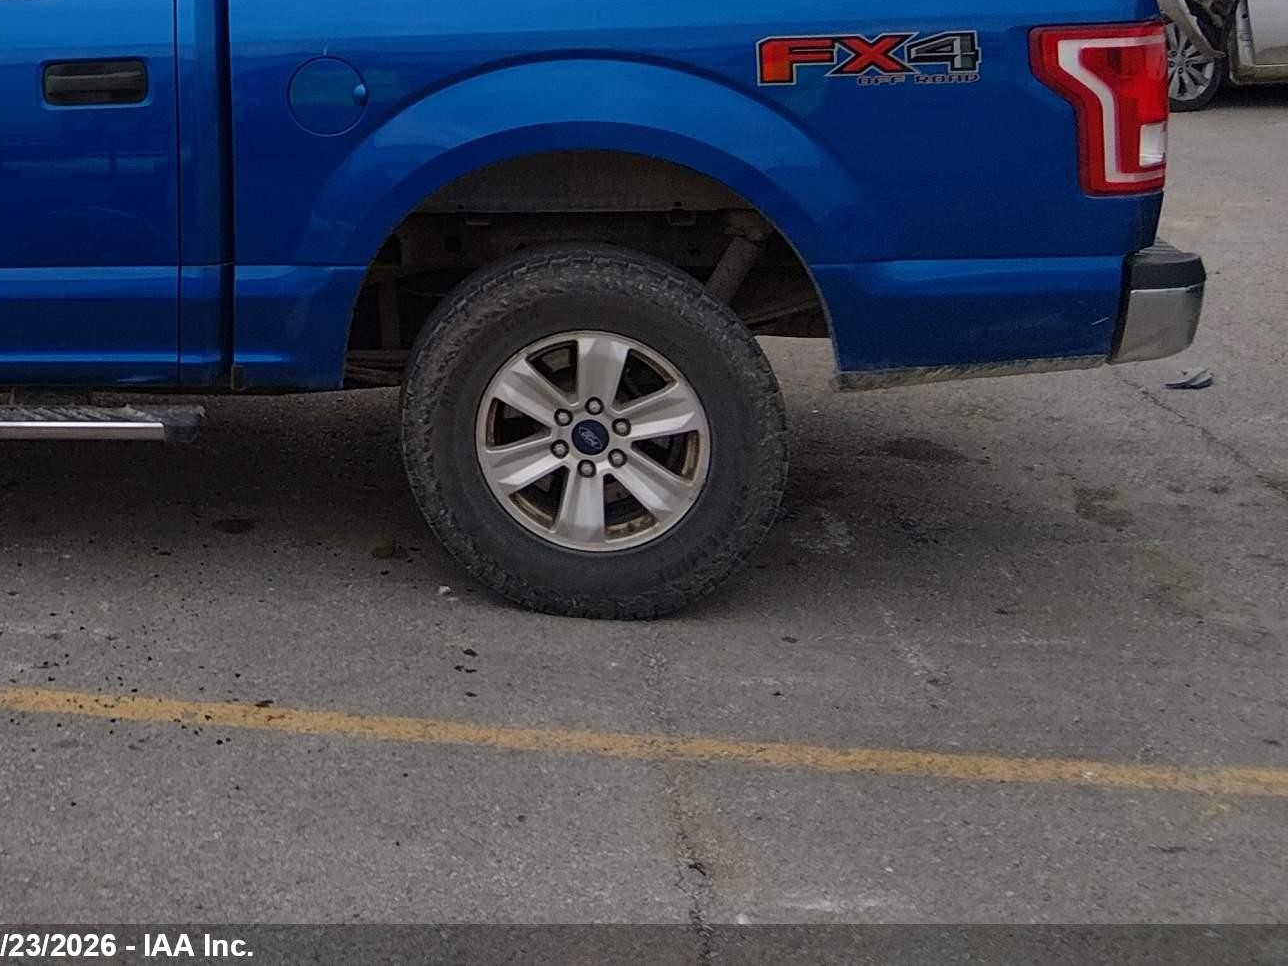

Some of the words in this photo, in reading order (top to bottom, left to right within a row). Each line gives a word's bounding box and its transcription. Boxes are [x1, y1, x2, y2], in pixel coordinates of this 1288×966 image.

[757, 31, 982, 85] FX4
[856, 75, 905, 85] OFF
[914, 74, 980, 83] ROAD
